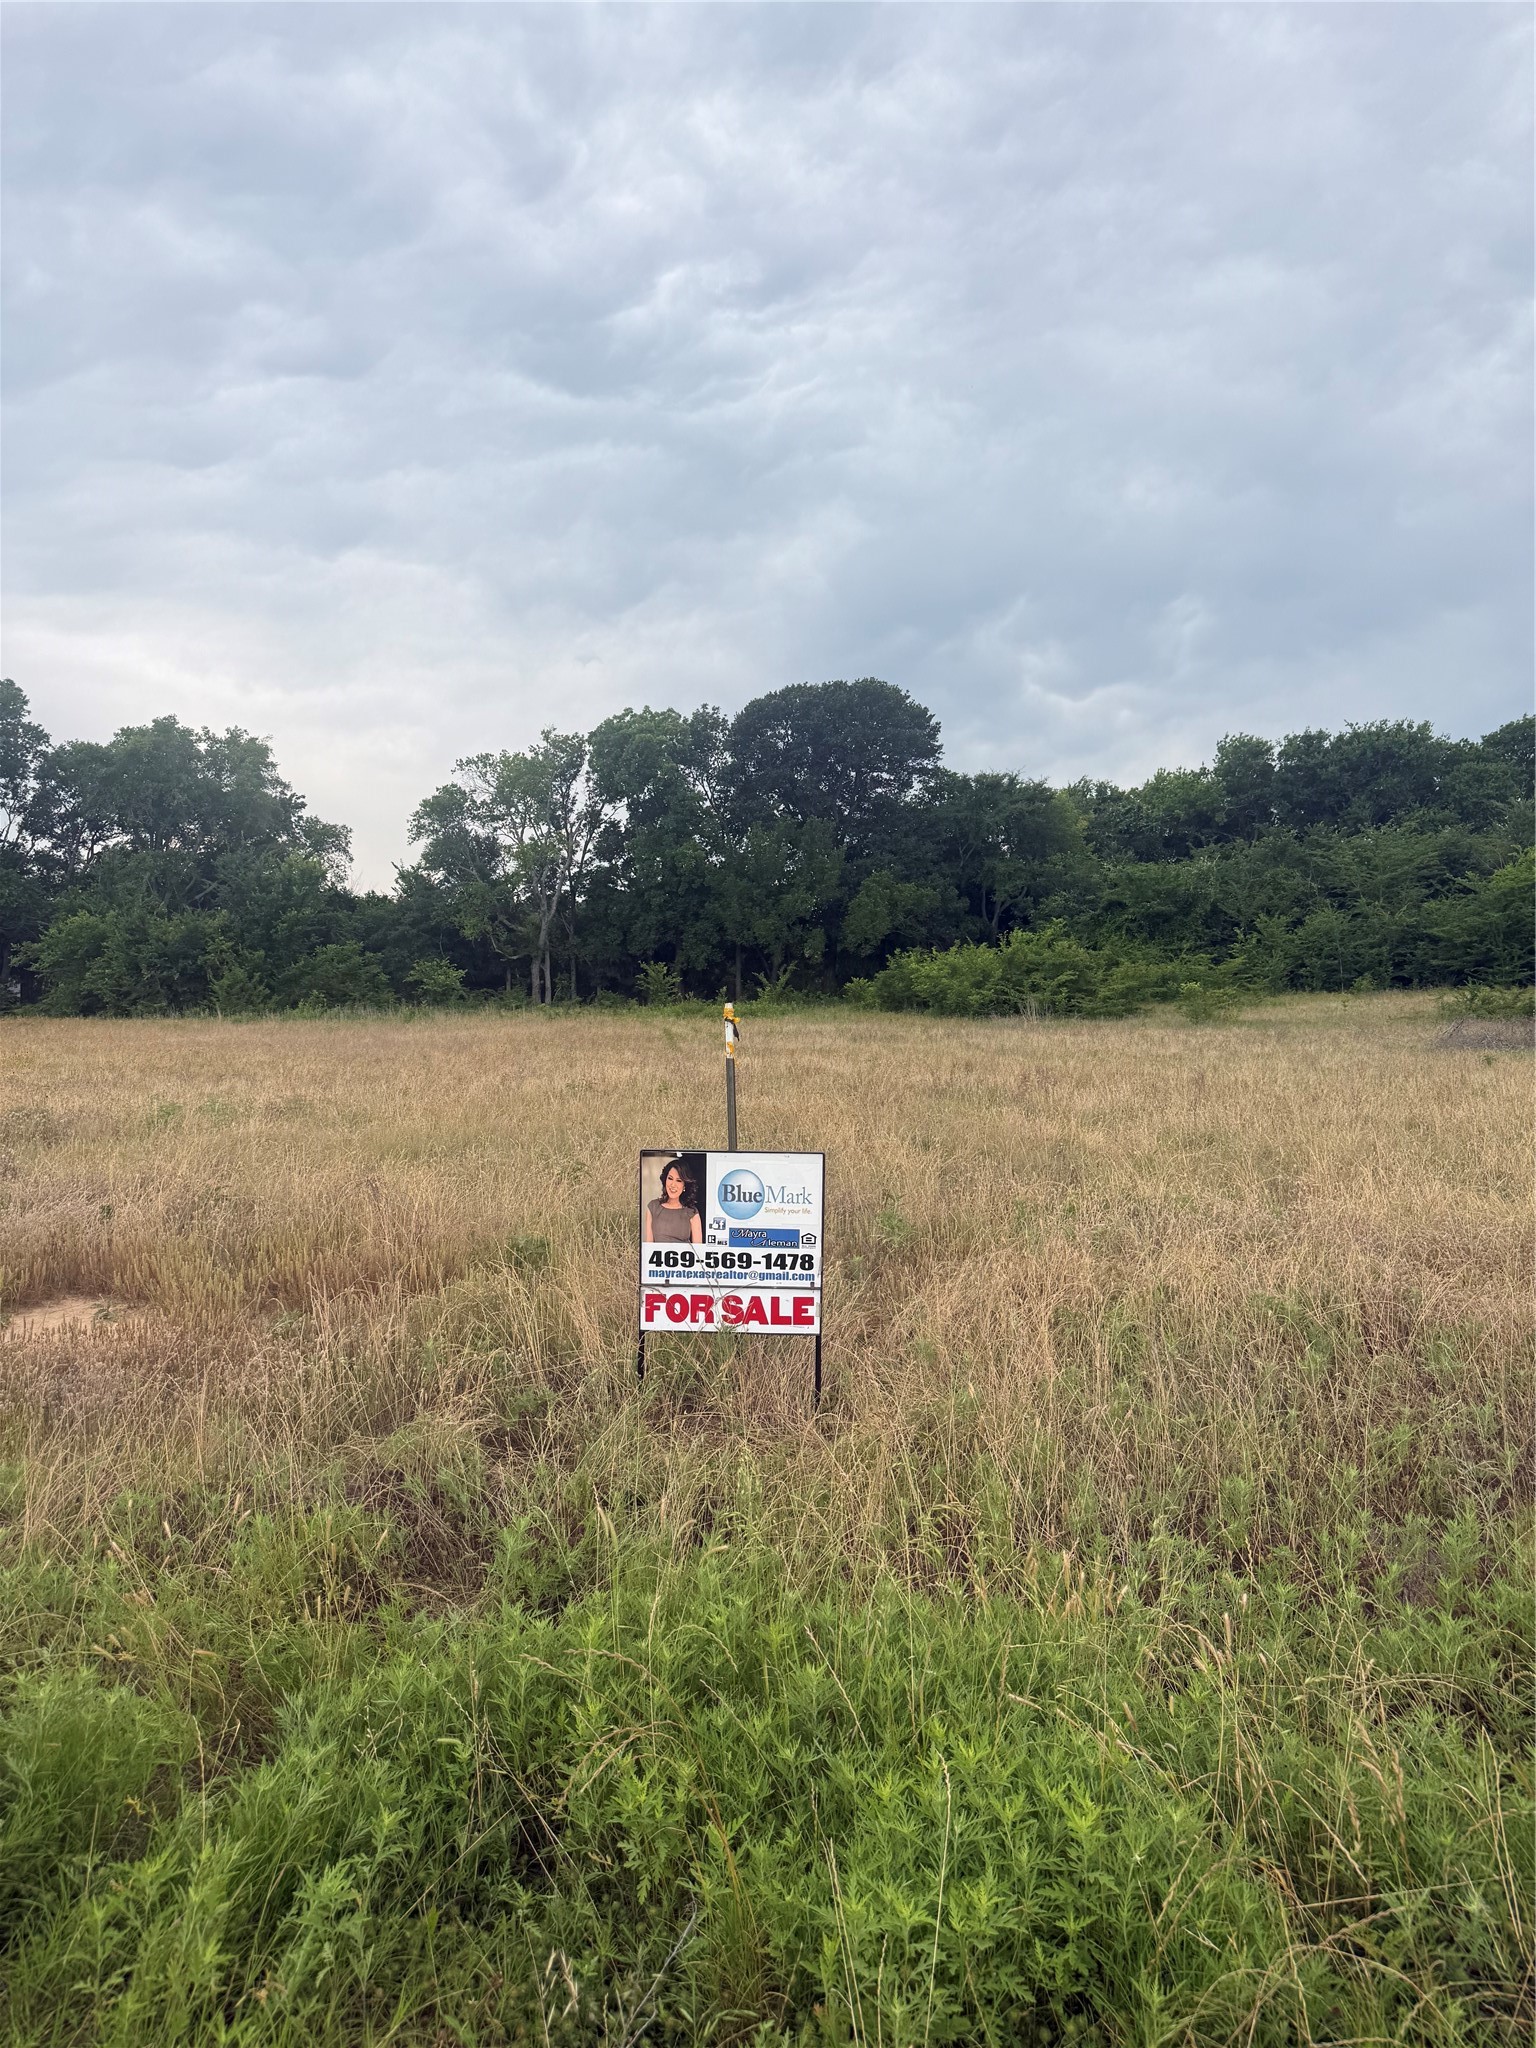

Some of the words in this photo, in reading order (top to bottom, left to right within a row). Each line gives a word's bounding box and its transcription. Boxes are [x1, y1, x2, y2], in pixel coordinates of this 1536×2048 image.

[722, 1184, 763, 1204] Blue
[765, 1185, 813, 1205] Mark
[764, 1207, 787, 1215] Simplify
[732, 1228, 767, 1239] Mayra
[750, 1238, 798, 1247] Aleman
[648, 1250, 814, 1271] 469-569-1478
[648, 1269, 815, 1282] mayratexasrealtor@gmail.com
[645, 1293, 715, 1324] FOR
[721, 1295, 815, 1326] SALE
